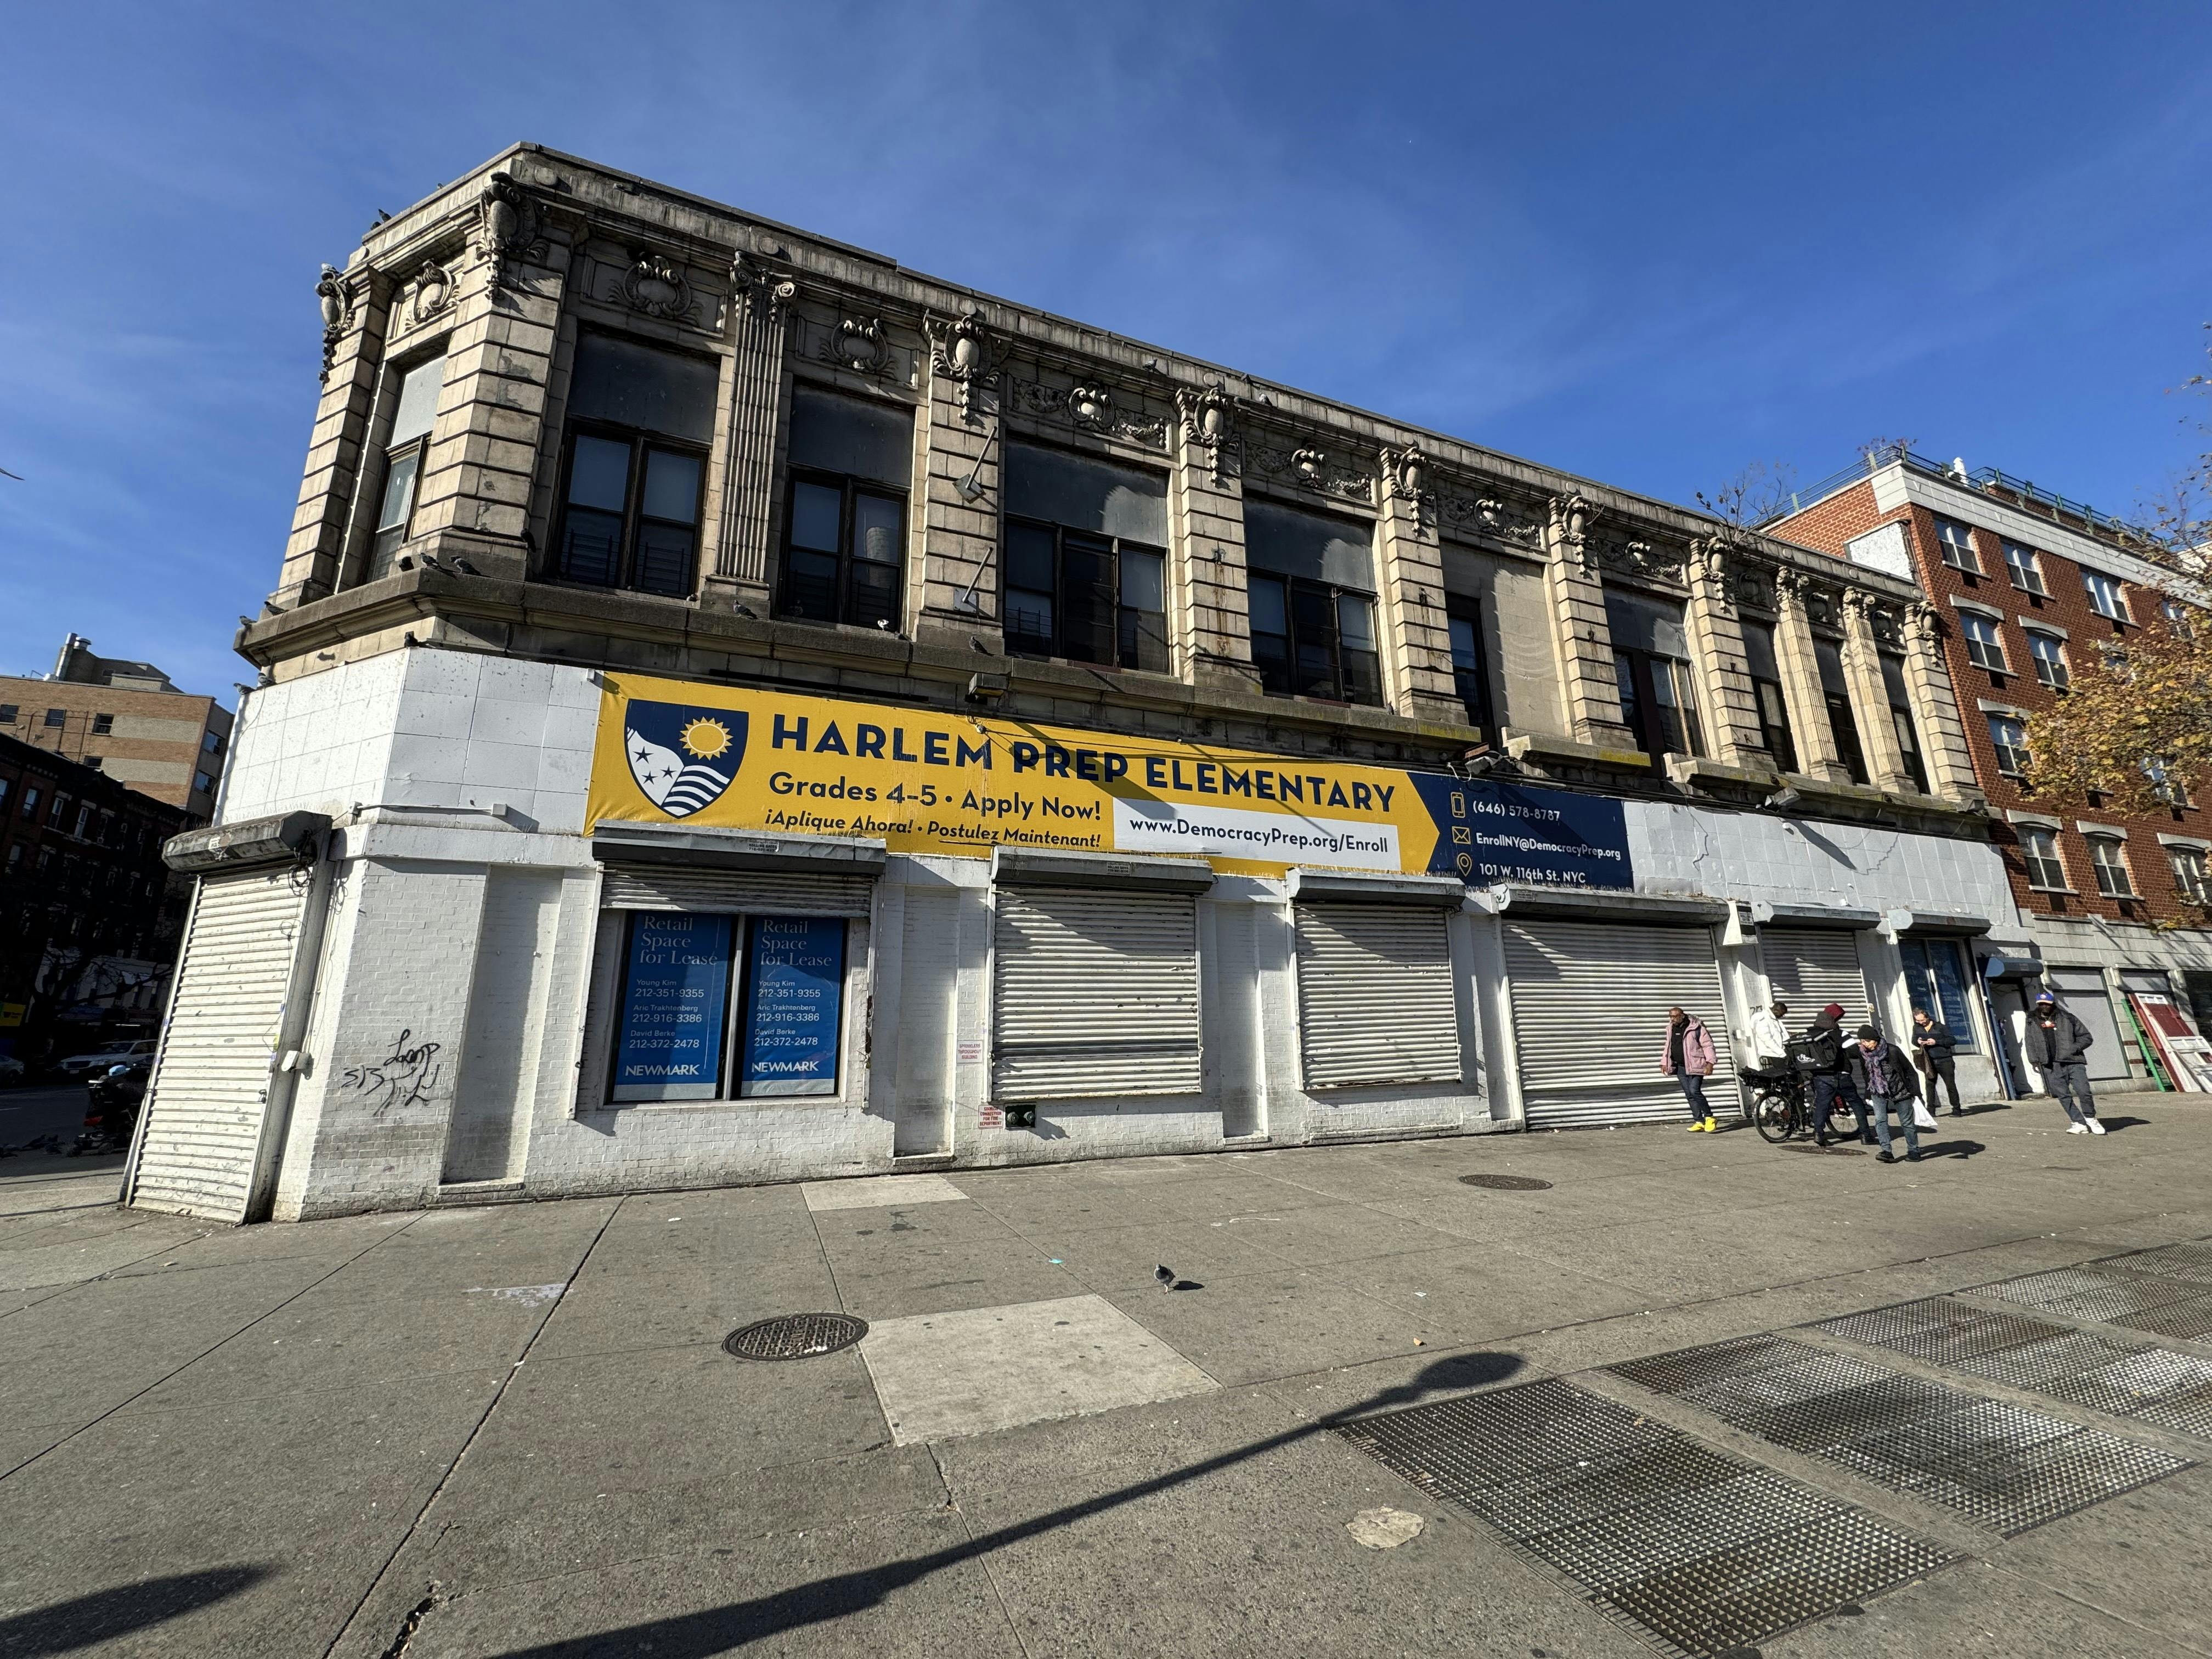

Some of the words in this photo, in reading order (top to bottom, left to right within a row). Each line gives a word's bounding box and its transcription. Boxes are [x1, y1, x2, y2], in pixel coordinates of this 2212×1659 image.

[772, 714, 992, 770] HARLEM
[1014, 741, 1128, 782] PREP
[1146, 757, 1395, 812] ELEMENTARY
[770, 772, 877, 802] Grades
[887, 782, 937, 806] 4-5
[961, 789, 1034, 820] Apply
[1042, 795, 1101, 821] Now!
[1473, 800, 1505, 816] (646)
[1509, 805, 1560, 821] 578-8787
[851, 815, 914, 834] Ahora!
[927, 821, 1000, 840] Postulez
[1004, 827, 1101, 847] Maintenant!
[1130, 819, 1387, 853] www.DemocracyPrep.org/Enroll
[1476, 833, 1621, 861] EnrollNY@DemocracyPrep.org
[1480, 864, 1497, 876] 101
[1500, 866, 1513, 878] W.
[1516, 867, 1543, 880] 116th
[1546, 870, 1560, 881] St.
[1564, 872, 1585, 883] NYC
[644, 916, 693, 930] Retail
[763, 919, 808, 933] Retail
[641, 932, 691, 951] Space
[761, 935, 807, 953] Space
[640, 950, 665, 963] for
[670, 951, 718, 965] Lease
[760, 952, 784, 966] for
[789, 952, 832, 966] Lease
[636, 979, 659, 987] Young
[635, 988, 704, 997] 212-351-9355
[758, 989, 820, 997] 212-351-9355
[632, 1014, 702, 1023] 212-916-3386
[756, 1013, 820, 1022] 212-916-3386
[629, 1039, 699, 1048] 212-372-2478
[754, 1037, 818, 1046] 212-372-2478
[625, 1064, 700, 1076] NEWMARK
[751, 1060, 820, 1073] NEWMARK
